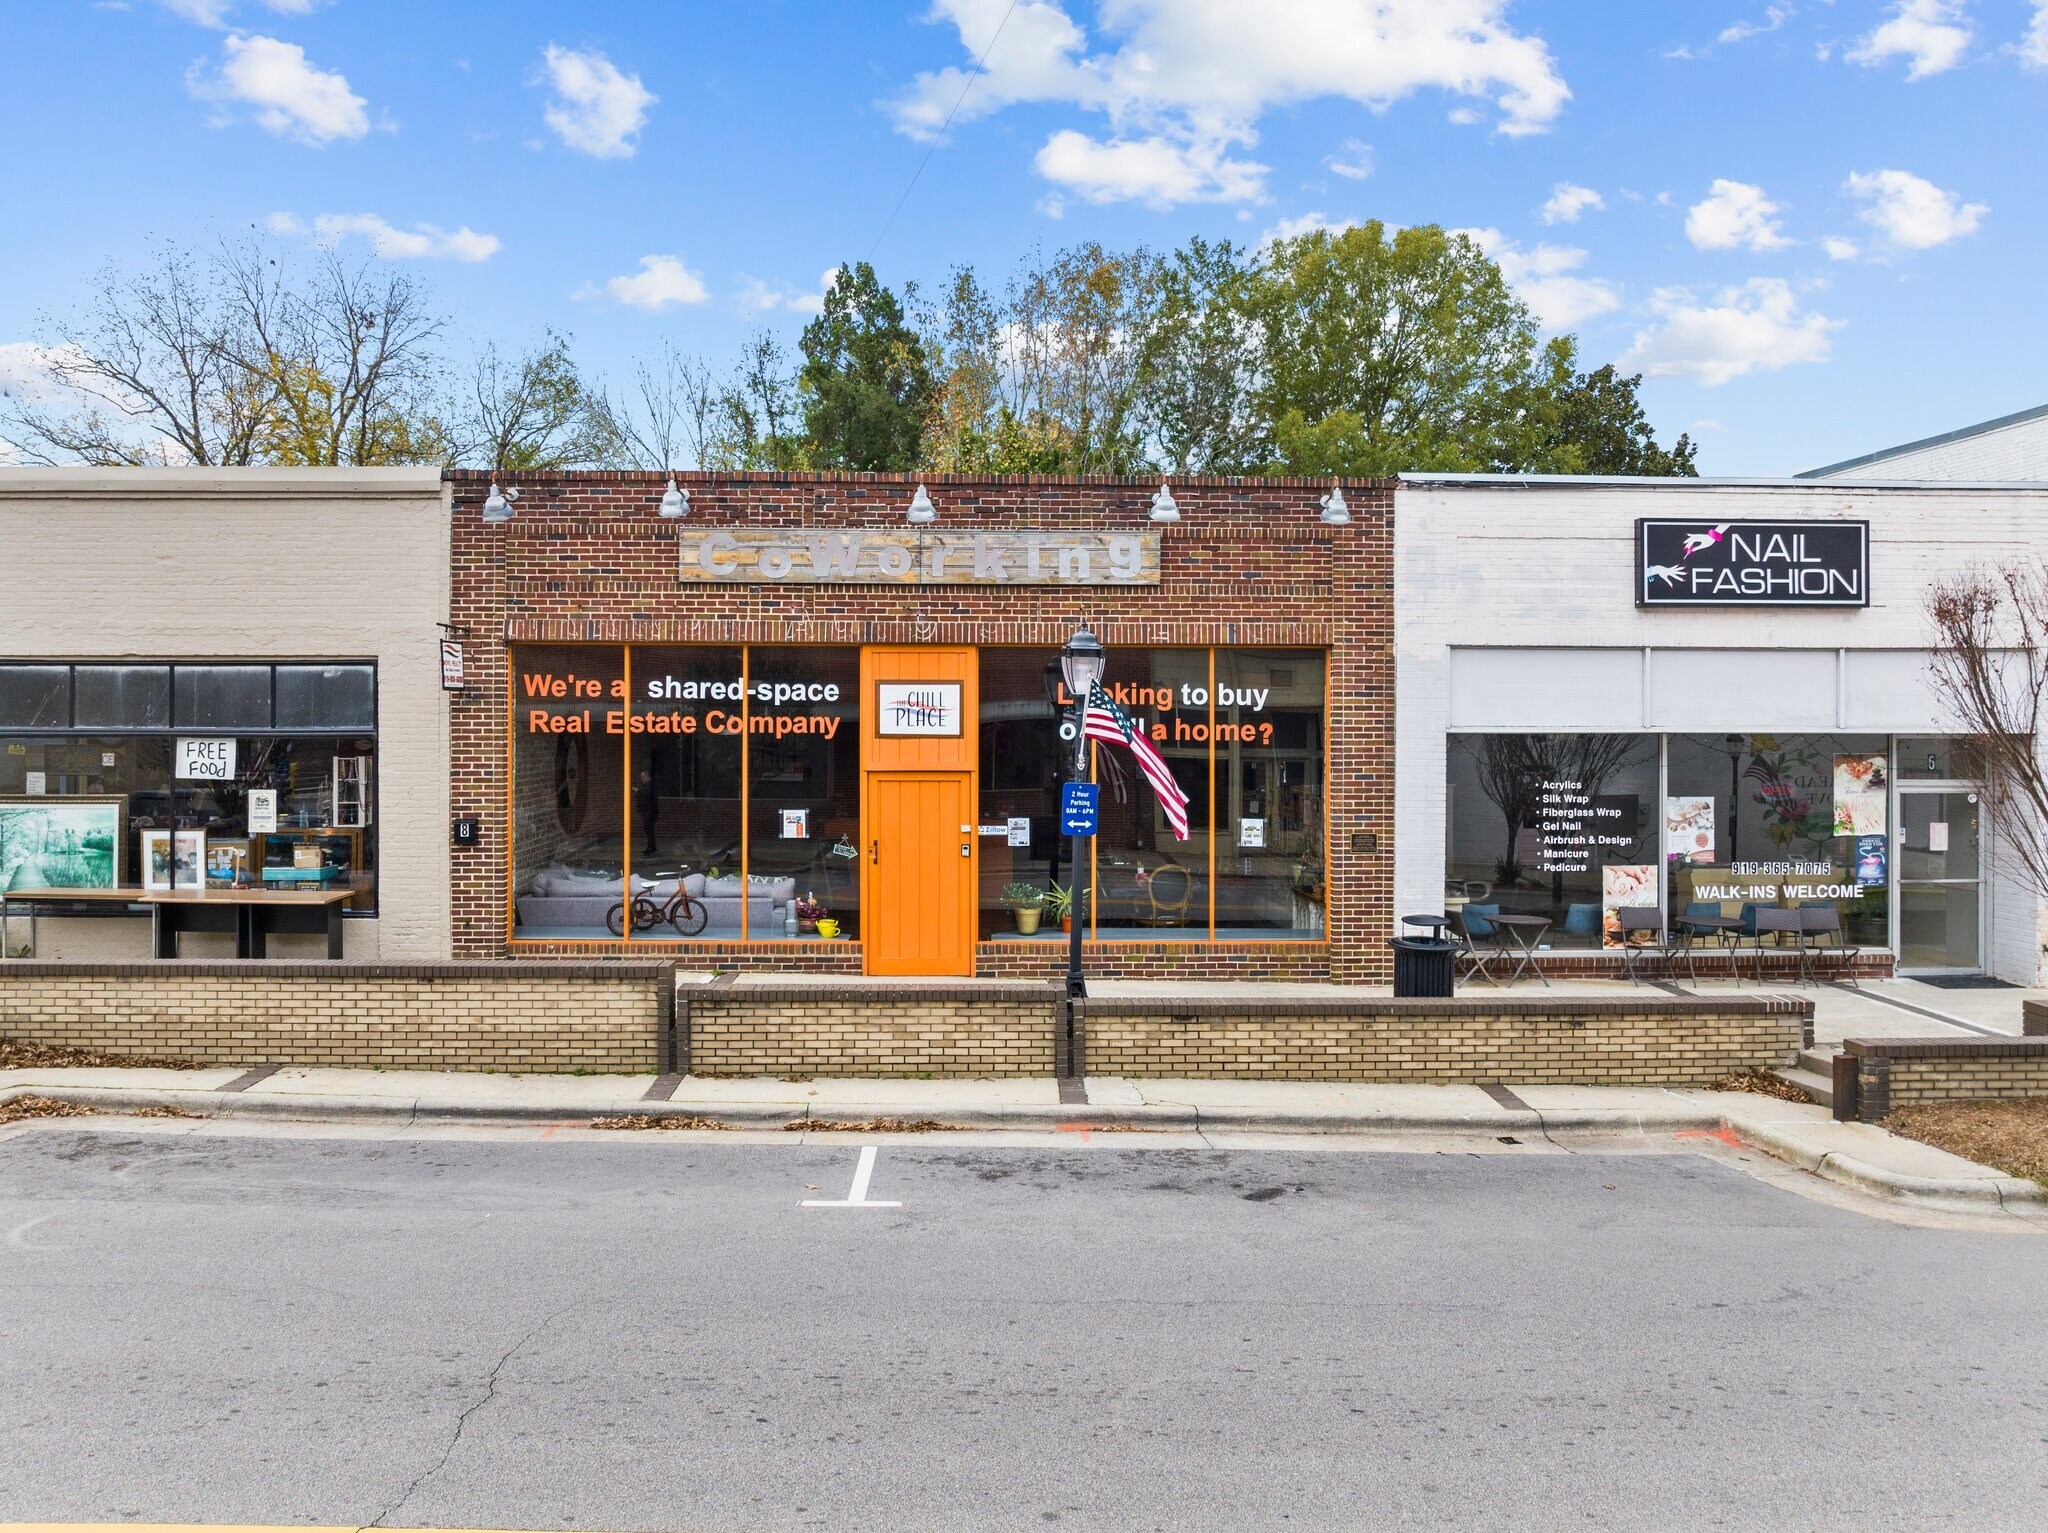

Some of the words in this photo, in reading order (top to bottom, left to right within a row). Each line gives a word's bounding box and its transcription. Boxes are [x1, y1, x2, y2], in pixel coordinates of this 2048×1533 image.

[1731, 533, 1822, 563] NAIL
[699, 534, 1142, 579] CoWorking
[1691, 567, 1858, 595] FASHION
[523, 673, 603, 698] We're
[610, 679, 625, 698] a
[647, 675, 841, 707] shared-space
[1057, 682, 1173, 711] Lking
[1180, 683, 1209, 706] to
[1217, 683, 1270, 711] buy
[907, 691, 946, 707] CHILL
[896, 707, 946, 727] PLACE
[529, 710, 591, 734] Real
[606, 710, 697, 734] Estate
[705, 710, 842, 740] Company
[1151, 722, 1168, 740] a
[1174, 717, 1274, 745] home?
[186, 741, 227, 760] FREE
[1928, 755, 1937, 771] 6
[1542, 780, 1582, 791] Acrylics
[1071, 790, 1076, 798] 2
[1542, 794, 1562, 804] Silk
[1563, 794, 1589, 806] Wrap
[1070, 799, 1091, 808] Parking
[1542, 807, 1594, 819] Fiberglass
[1596, 808, 1622, 819] Wrap
[461, 824, 469, 836] 8
[1542, 821, 1560, 831] Gel
[1562, 821, 1582, 831] Nail
[1543, 834, 1586, 845] Airbrush
[1588, 835, 1596, 845] &
[1597, 834, 1632, 847] Design
[1543, 848, 1589, 859] Manicure
[1543, 862, 1587, 873] Pedicure
[1731, 861, 1831, 876] 919-365-7075
[1695, 885, 1777, 899] WALK-INS
[1783, 884, 1864, 899] WELCOME
